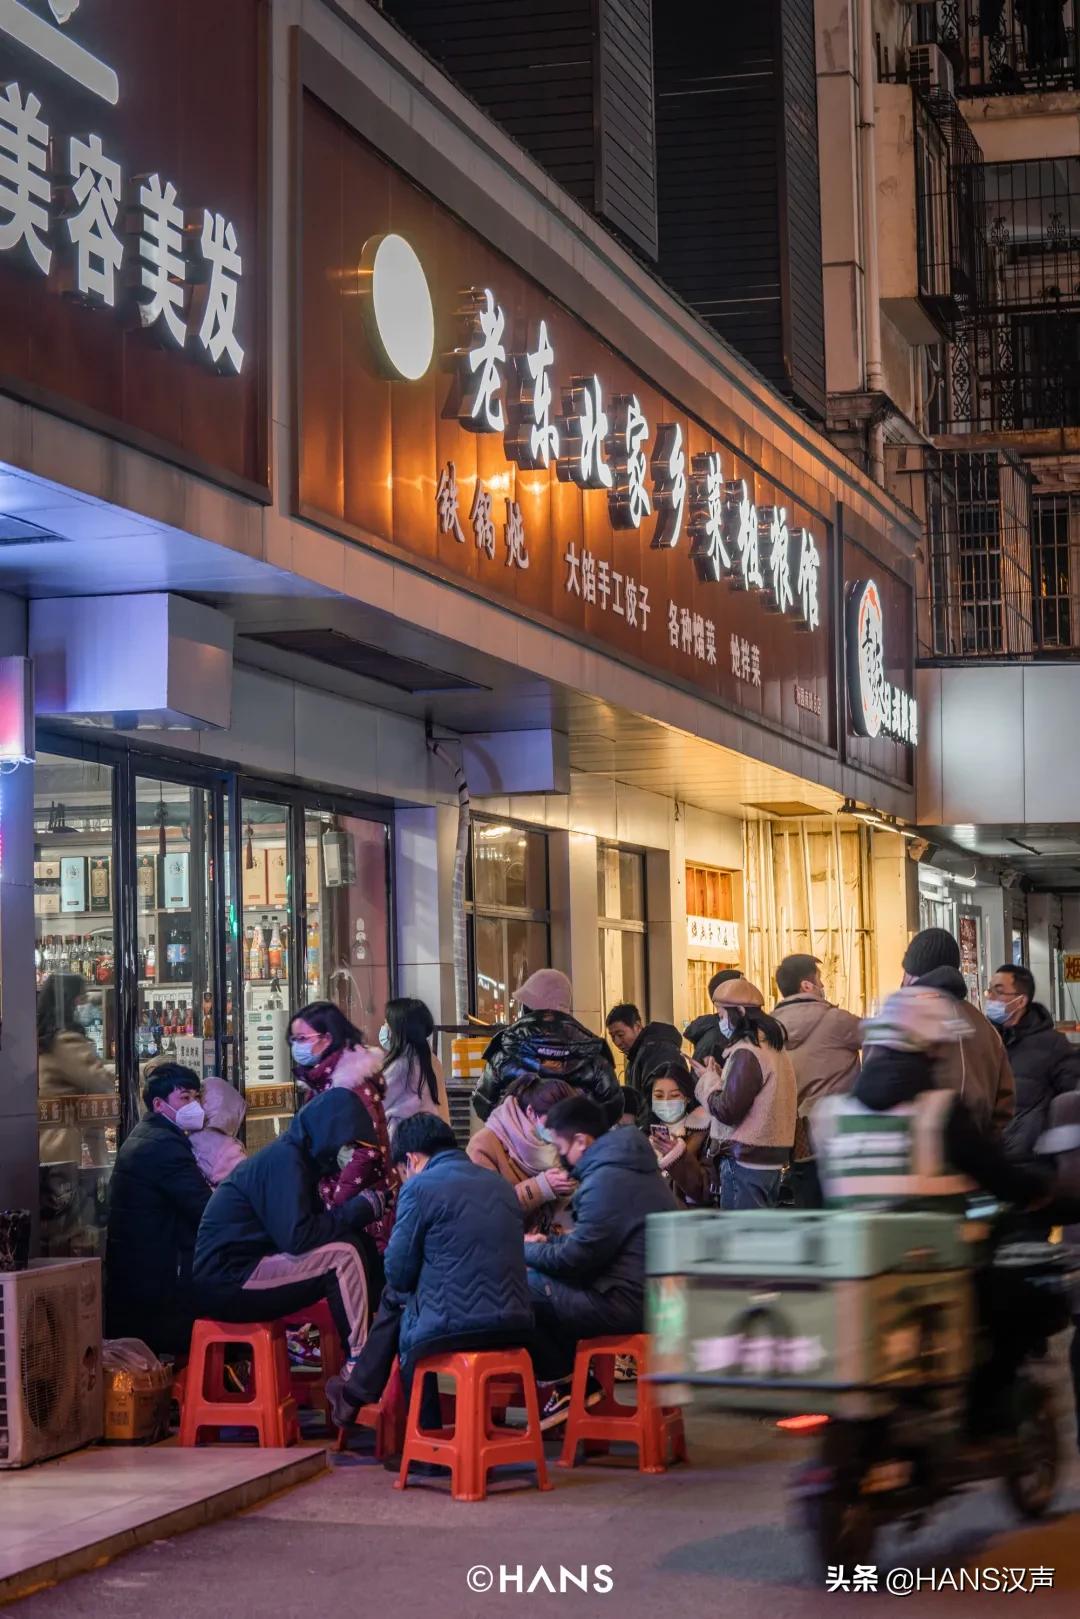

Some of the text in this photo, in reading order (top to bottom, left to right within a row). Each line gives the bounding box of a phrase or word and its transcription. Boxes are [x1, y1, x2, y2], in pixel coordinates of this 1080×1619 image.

[0, 82, 245, 374] 美容美发
[436, 460, 530, 569] 铁锅炖
[469, 287, 821, 631] 老东北家乡菜粗粮馆
[564, 541, 651, 632] 大馅手工饺子
